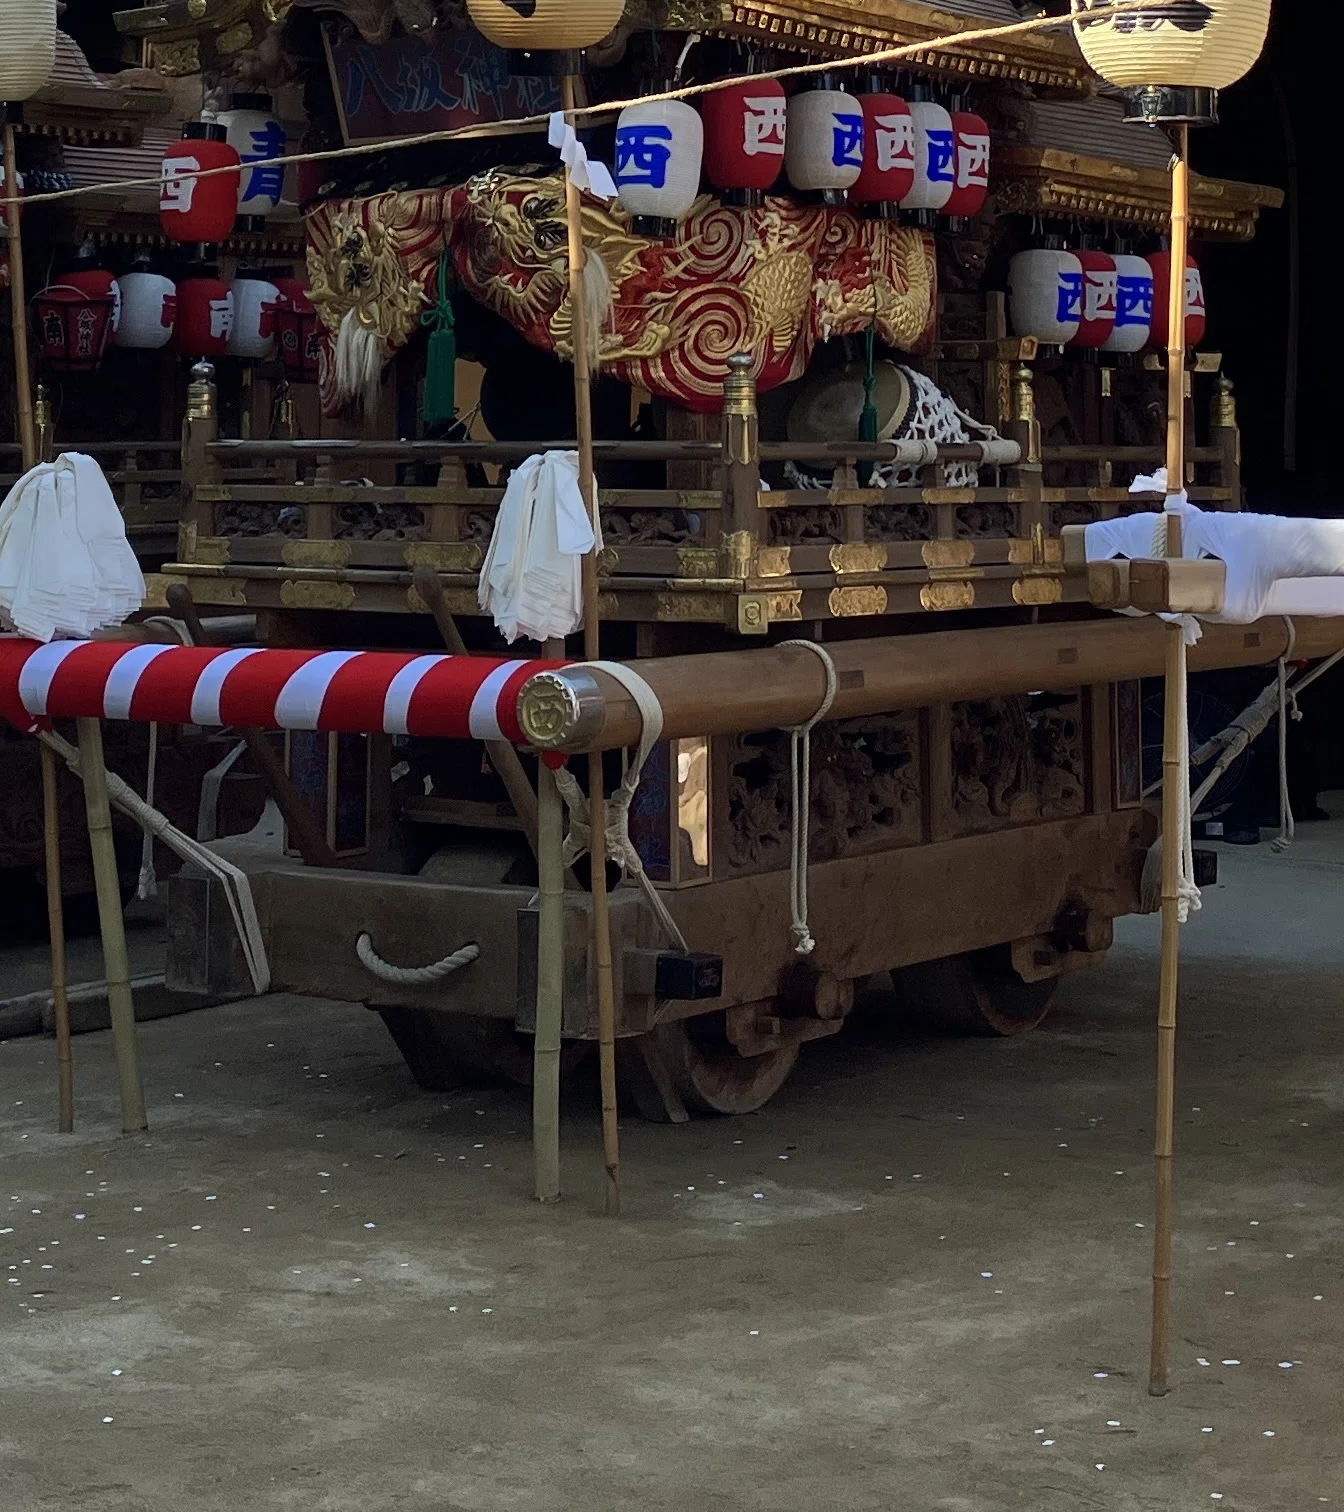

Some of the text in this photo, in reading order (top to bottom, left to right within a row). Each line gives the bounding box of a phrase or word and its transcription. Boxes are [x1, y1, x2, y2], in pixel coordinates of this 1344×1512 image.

[743, 96, 787, 157] 西
[875, 114, 916, 172] 西
[159, 155, 201, 214] 西
[240, 121, 286, 208] 青
[616, 124, 674, 189] 西
[958, 131, 991, 188] 西
[1083, 270, 1117, 322] 西
[1115, 274, 1154, 327] 西
